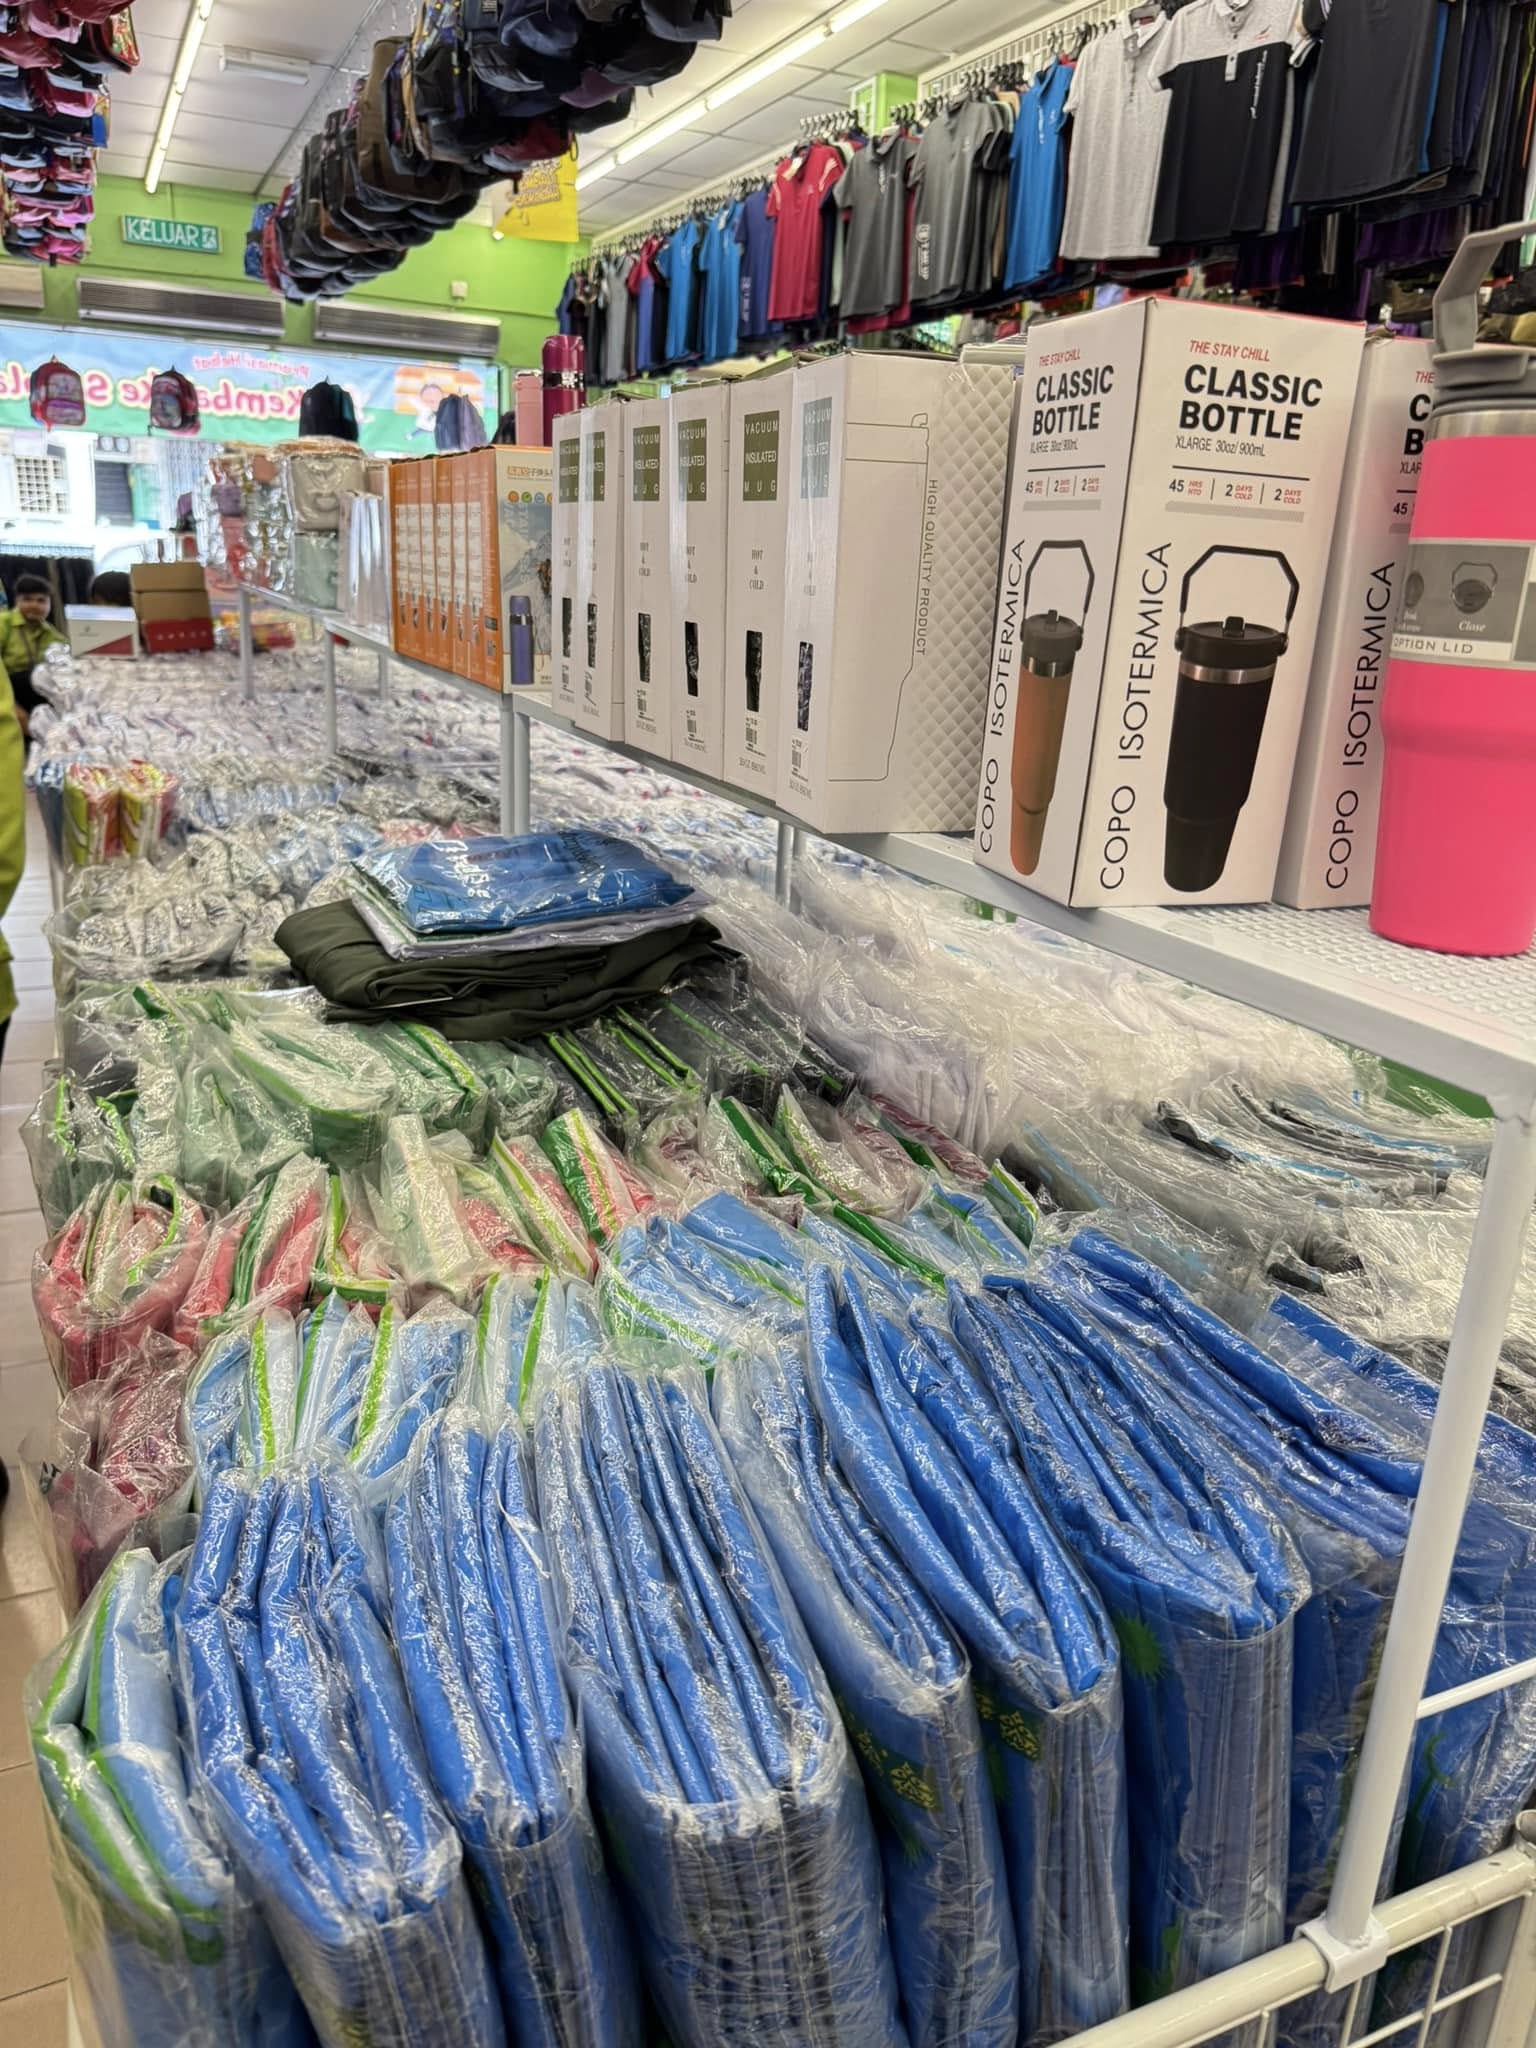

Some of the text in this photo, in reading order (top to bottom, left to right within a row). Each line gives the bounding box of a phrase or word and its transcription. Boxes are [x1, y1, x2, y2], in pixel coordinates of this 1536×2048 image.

[127, 217, 199, 247] KELUAR
[1189, 339, 1270, 362] THE STAY CHILL
[1036, 365, 1114, 404] CLASSIC
[1415, 371, 1435, 384] THE
[1184, 364, 1323, 408] CLASSIC
[1032, 402, 1101, 436] BOTTLE
[1179, 400, 1303, 441] BOTTLE
[745, 420, 778, 434] VACUUM
[1175, 435, 1212, 452] XLARGE
[745, 450, 777, 465] INSULATED
[1053, 480, 1059, 492] 2
[1081, 478, 1087, 491] 2
[1169, 479, 1185, 492] 45
[1225, 484, 1233, 497] 2
[1235, 485, 1253, 493] DAYS
[1234, 492, 1253, 501] COLD
[1274, 488, 1282, 501] 2
[1284, 489, 1302, 497] DAYS
[1283, 496, 1302, 505] COLD
[1393, 502, 1408, 515] 45
[915, 479, 938, 656] HIGH QUALITY PRODUCT
[1458, 620, 1486, 632] Close
[1393, 638, 1473, 654] OPTION LID
[980, 539, 1025, 853] COPO ISOTERMICA
[1100, 542, 1172, 890] COPO ISOTERMICA
[1326, 561, 1395, 889] COPO ISOTERMICA
